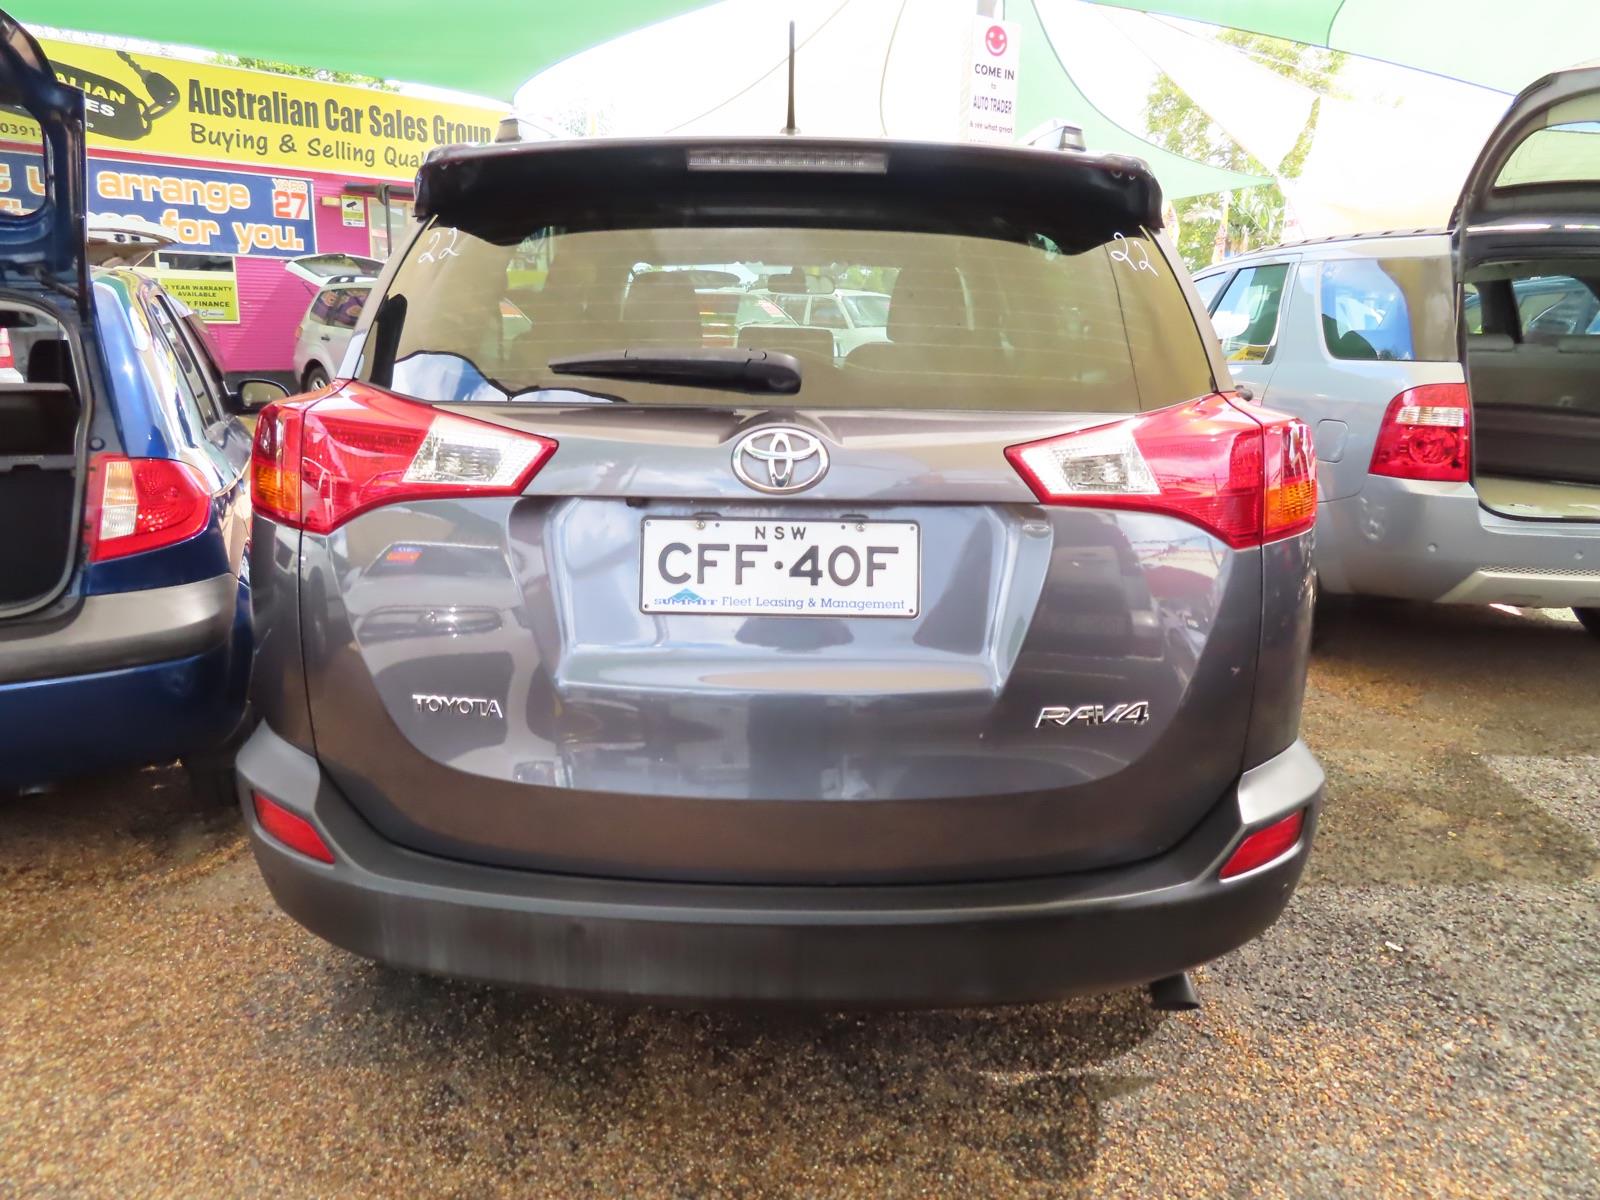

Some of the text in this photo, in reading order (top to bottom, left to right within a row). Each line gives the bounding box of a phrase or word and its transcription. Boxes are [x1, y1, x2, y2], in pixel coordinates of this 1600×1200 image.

[974, 63, 1015, 80] COME IN
[188, 78, 491, 146] Australian Car Sales Group
[973, 95, 1012, 114] AUTO TRADER
[190, 123, 268, 156] Buying
[279, 133, 298, 153] &
[308, 138, 376, 168] Selling
[97, 171, 251, 213] arrange
[273, 189, 308, 219] 27
[160, 209, 305, 254] for you.
[418, 226, 461, 264] 22
[1110, 231, 1160, 278] 22
[193, 300, 230, 308] FINANCE
[754, 525, 807, 541] NSW
[721, 595, 752, 608] Fleet
[756, 596, 804, 610] Leasing
[808, 597, 817, 609] &
[819, 597, 905, 611] Management
[412, 694, 503, 718] TOYOTA
[1034, 701, 1150, 728] RAV4
